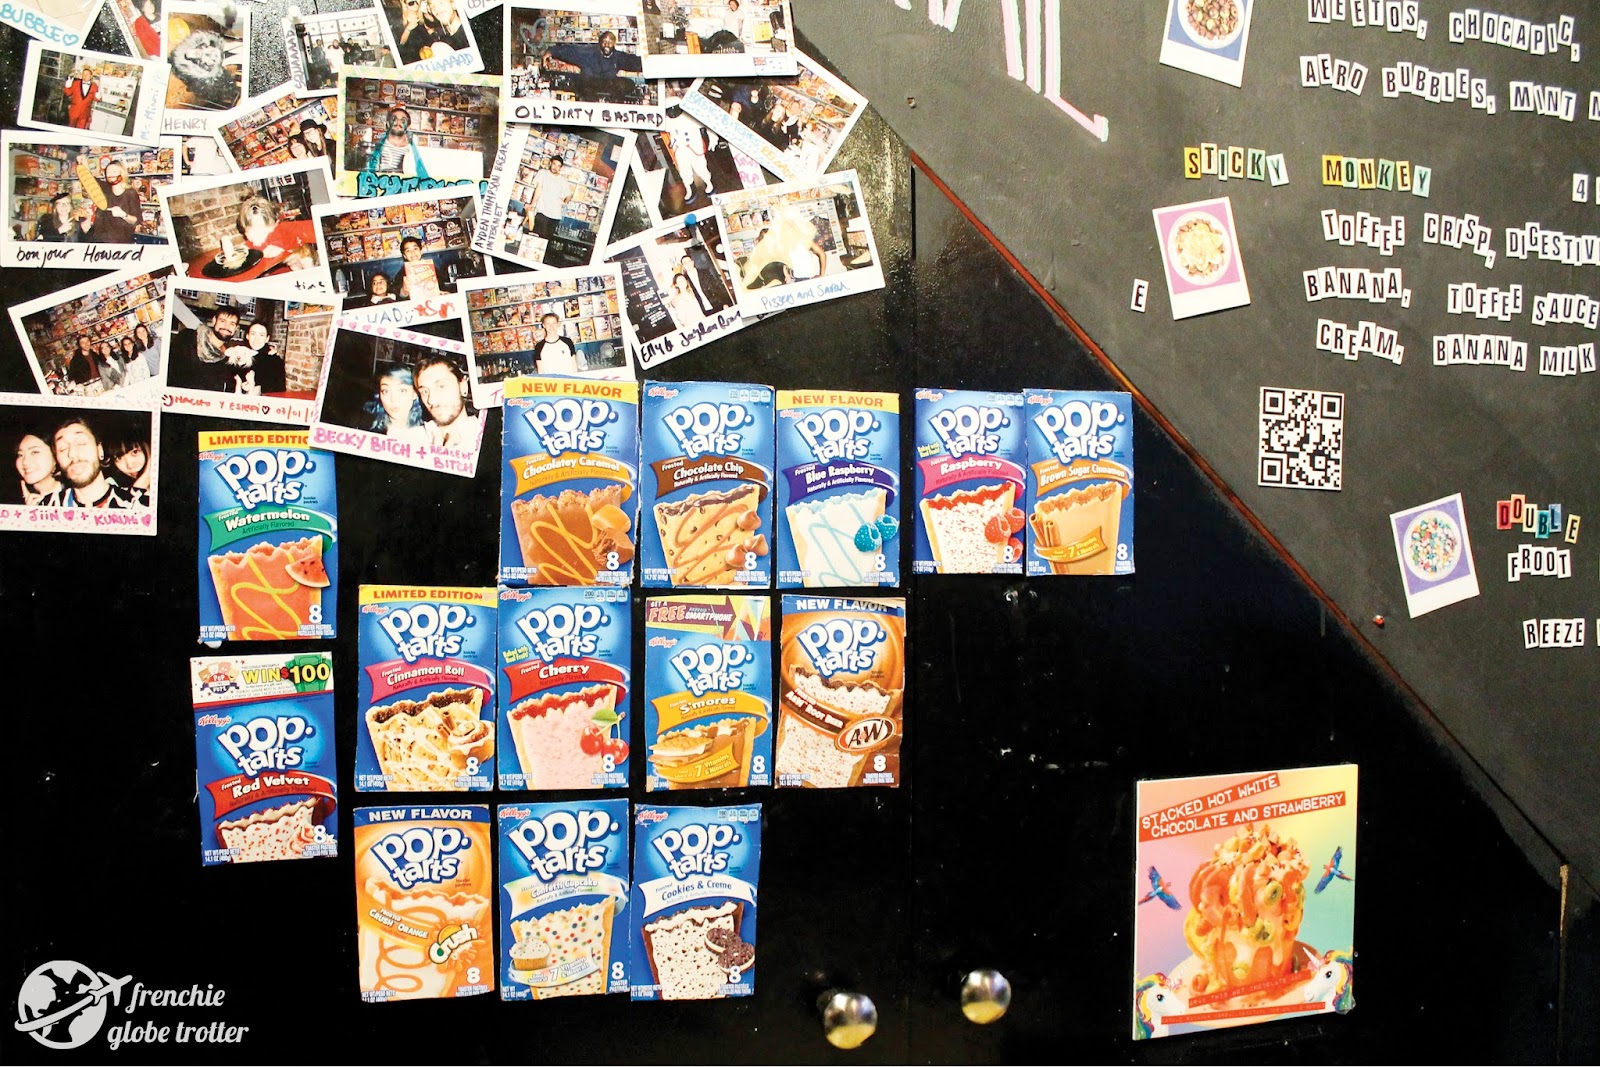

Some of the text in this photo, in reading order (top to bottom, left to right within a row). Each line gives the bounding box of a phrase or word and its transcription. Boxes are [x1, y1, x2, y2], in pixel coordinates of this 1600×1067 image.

[0, 4, 63, 42] BUBBLE
[1306, 59, 1363, 90] AERO
[1514, 87, 1574, 116] MINT
[165, 117, 207, 130] HENRY
[516, 105, 664, 127] OL' DIRTY BASTARD
[495, 142, 509, 171] BREAK
[1189, 147, 1281, 180] STICKY
[1326, 160, 1427, 188] MONKEY
[486, 203, 504, 250] INTERNET
[1326, 213, 1402, 252] TOFFEE
[1508, 227, 1600, 258] DIGESTIV
[83, 246, 143, 262] Howard
[1452, 288, 1520, 316] TOFFEE
[1536, 297, 1597, 324] SAUCE
[1437, 337, 1525, 367] BANANA
[1544, 347, 1593, 372] MILK
[522, 383, 622, 398] NEW FLAVOR
[793, 395, 883, 407] NEW FLAVOR
[209, 434, 309, 445] LIMITED EDITIO
[314, 428, 410, 458] BECKY BITCH
[434, 458, 473, 474] BITCH
[523, 457, 619, 479] Chocolatey Caramel
[662, 461, 684, 471] Frosted
[674, 461, 744, 480] Chocolate Chip
[795, 465, 816, 476] Frosted
[806, 466, 874, 484] Blue Raspberry
[940, 457, 1003, 475] Raspberry
[1040, 464, 1125, 486] Brown Sugar Cinnamon
[225, 509, 310, 531] Watermelon
[1003, 545, 1013, 562] 8
[1117, 543, 1128, 560] 8
[606, 552, 619, 570] 8
[745, 552, 757, 570] 8
[874, 554, 886, 571] 8
[1512, 549, 1567, 577] FROOT
[373, 590, 483, 600] LIMITED EDITION
[650, 605, 733, 622] FREE SMARTPHONE
[796, 599, 829, 610] NEW
[309, 605, 322, 623] 8
[1527, 622, 1583, 644] REEZE
[242, 668, 281, 684] WIN
[381, 666, 402, 677] Frosted
[386, 666, 465, 686] Cinnamon Roll
[520, 664, 540, 675] Frosted
[539, 664, 590, 679] Cherry
[679, 697, 736, 715] S'mores
[198, 715, 231, 727] Kellogg's
[805, 704, 844, 729] ROOT BEER
[465, 757, 479, 775] 8
[602, 754, 614, 772] 8
[753, 755, 765, 773] 8
[874, 755, 886, 772] 8
[221, 778, 241, 791] Frosted
[232, 780, 261, 798] Red
[263, 776, 310, 787] Velvet
[1142, 775, 1278, 828] STACKED HOT WHITE
[369, 809, 472, 821] NEW FLAVOR
[1151, 793, 1343, 837] CHOCOLATE AND STRAWBERRY
[314, 825, 325, 843] 8
[565, 880, 598, 889] Cupcake
[662, 881, 732, 901] Cookies & Creme
[369, 909, 428, 939] CRUSH ORANGE
[429, 924, 478, 964] Crush
[467, 967, 480, 984] 8
[612, 962, 624, 979] 8
[729, 966, 741, 983] 8
